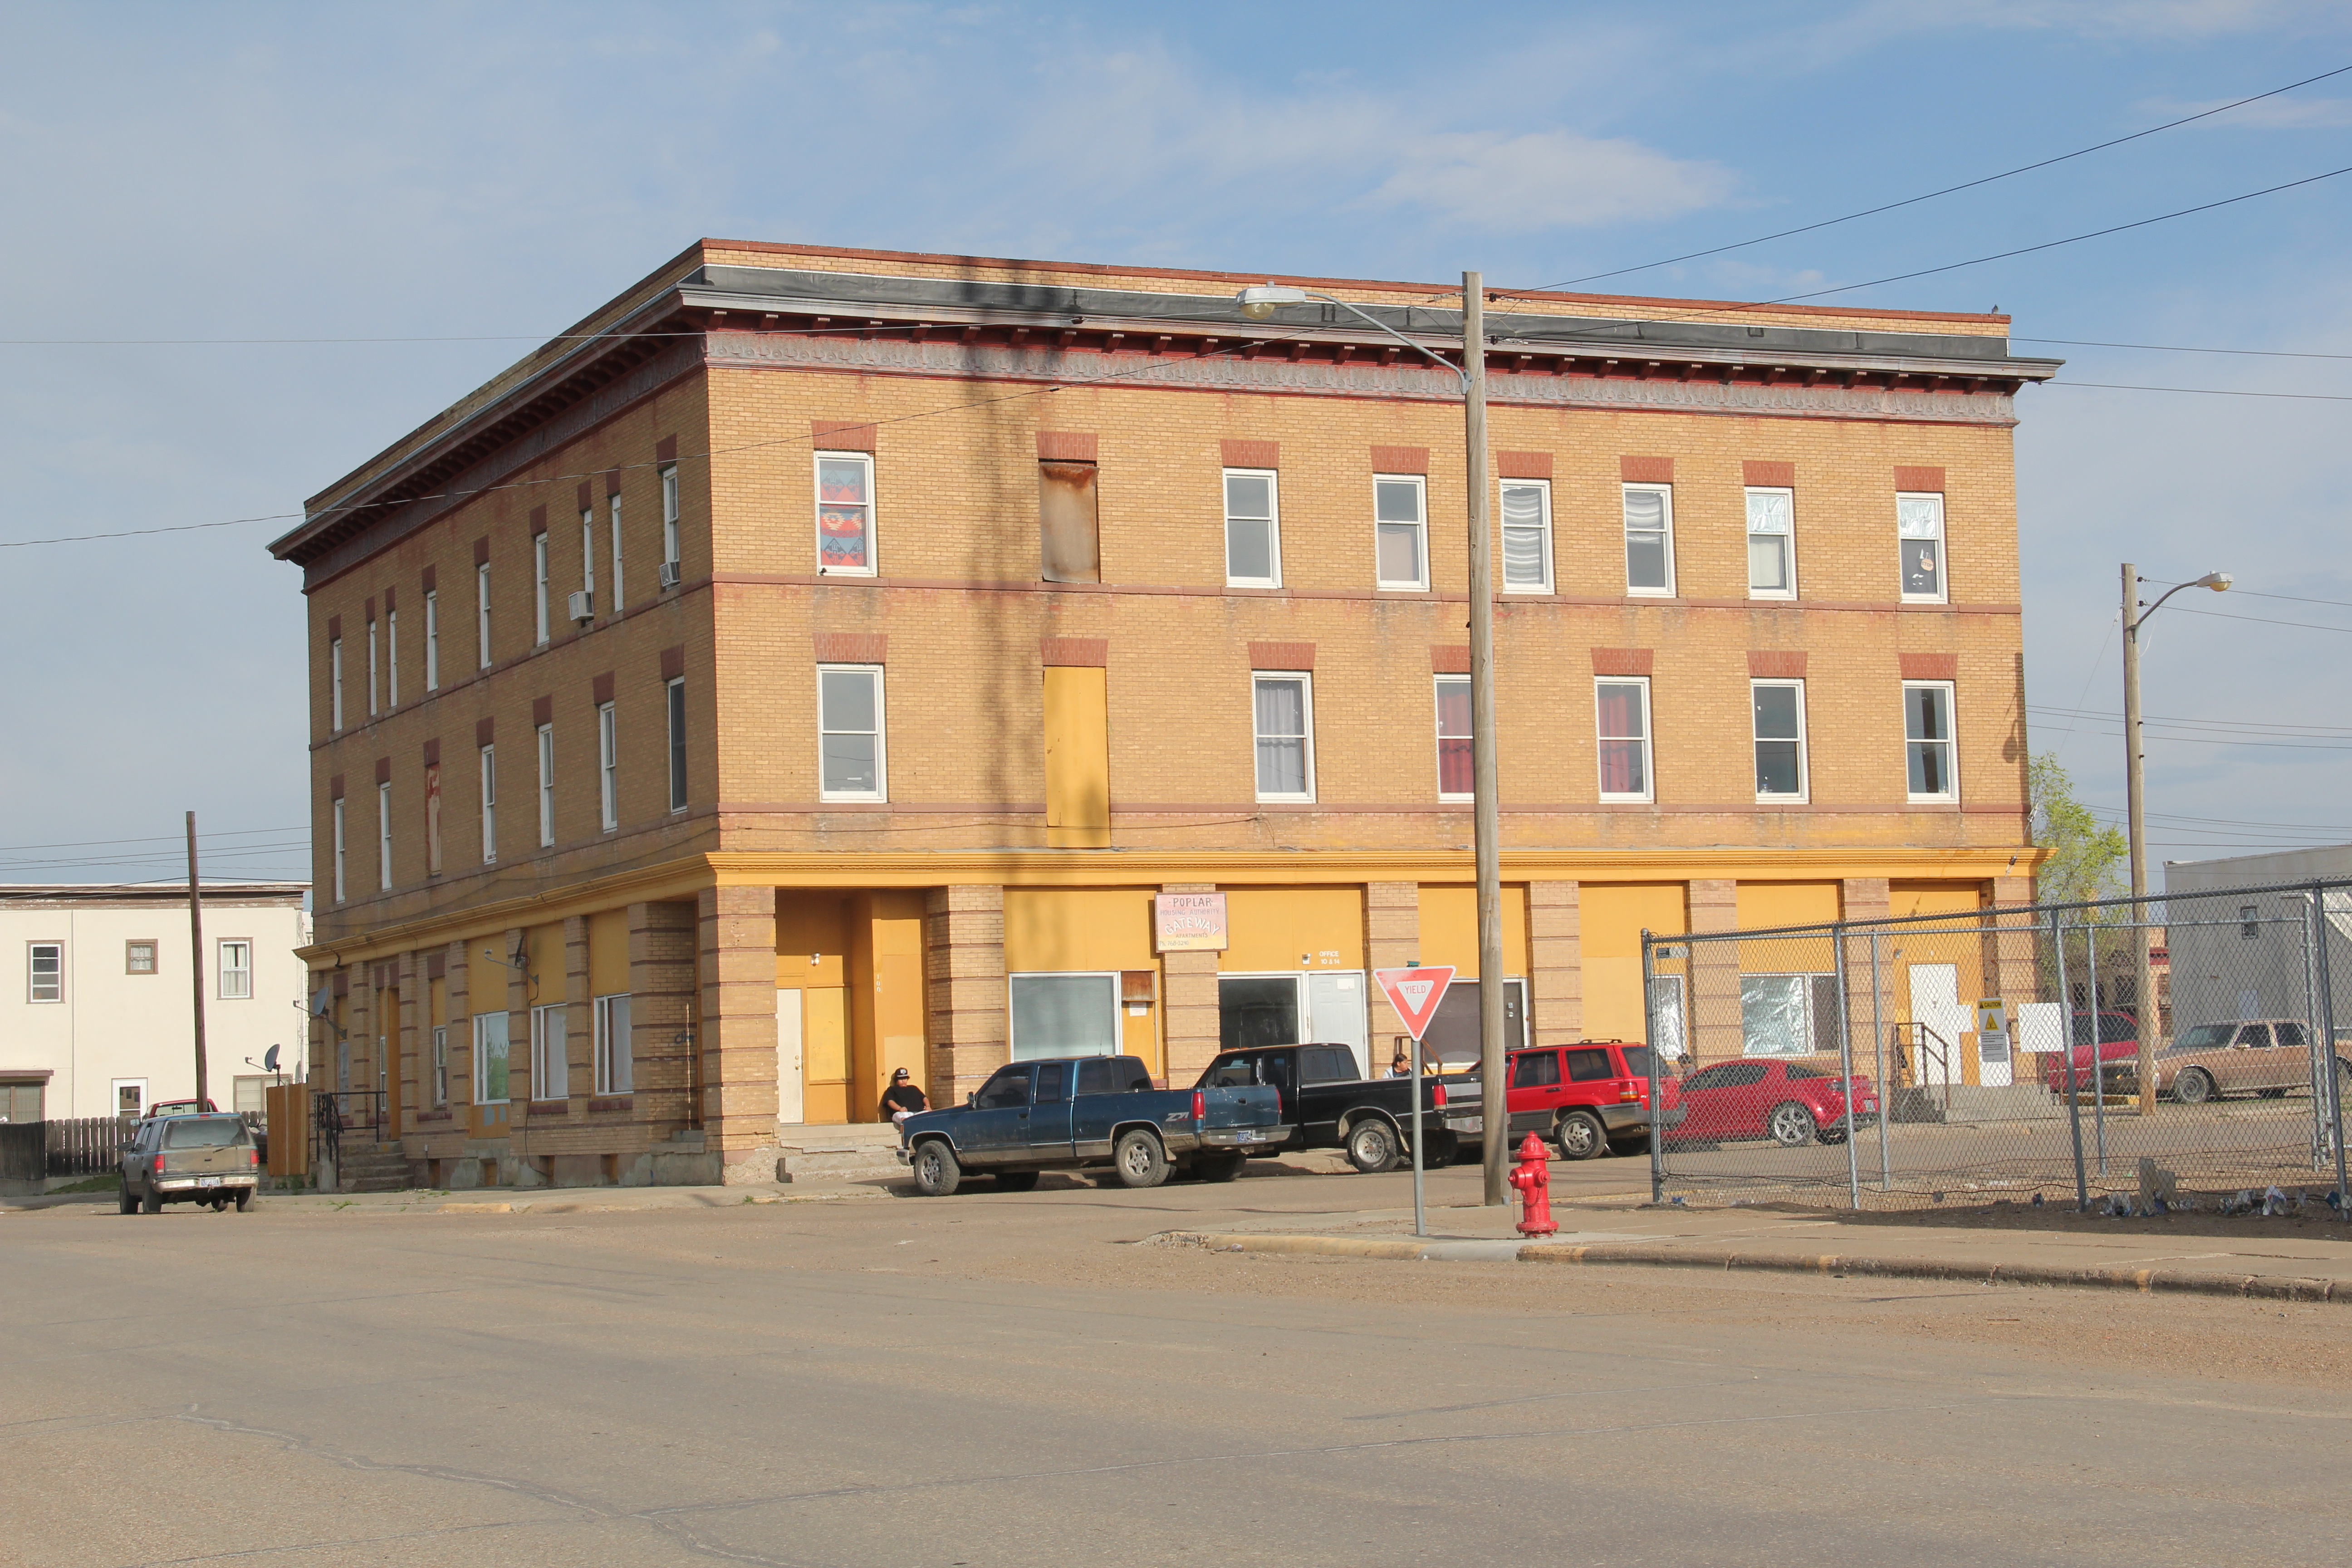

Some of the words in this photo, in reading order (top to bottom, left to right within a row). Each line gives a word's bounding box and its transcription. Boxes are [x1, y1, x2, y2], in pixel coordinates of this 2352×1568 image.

[1173, 897, 1212, 907] POPLAR
[1165, 916, 1220, 935] GATEWAY
[1404, 985, 1426, 994] YIELD
